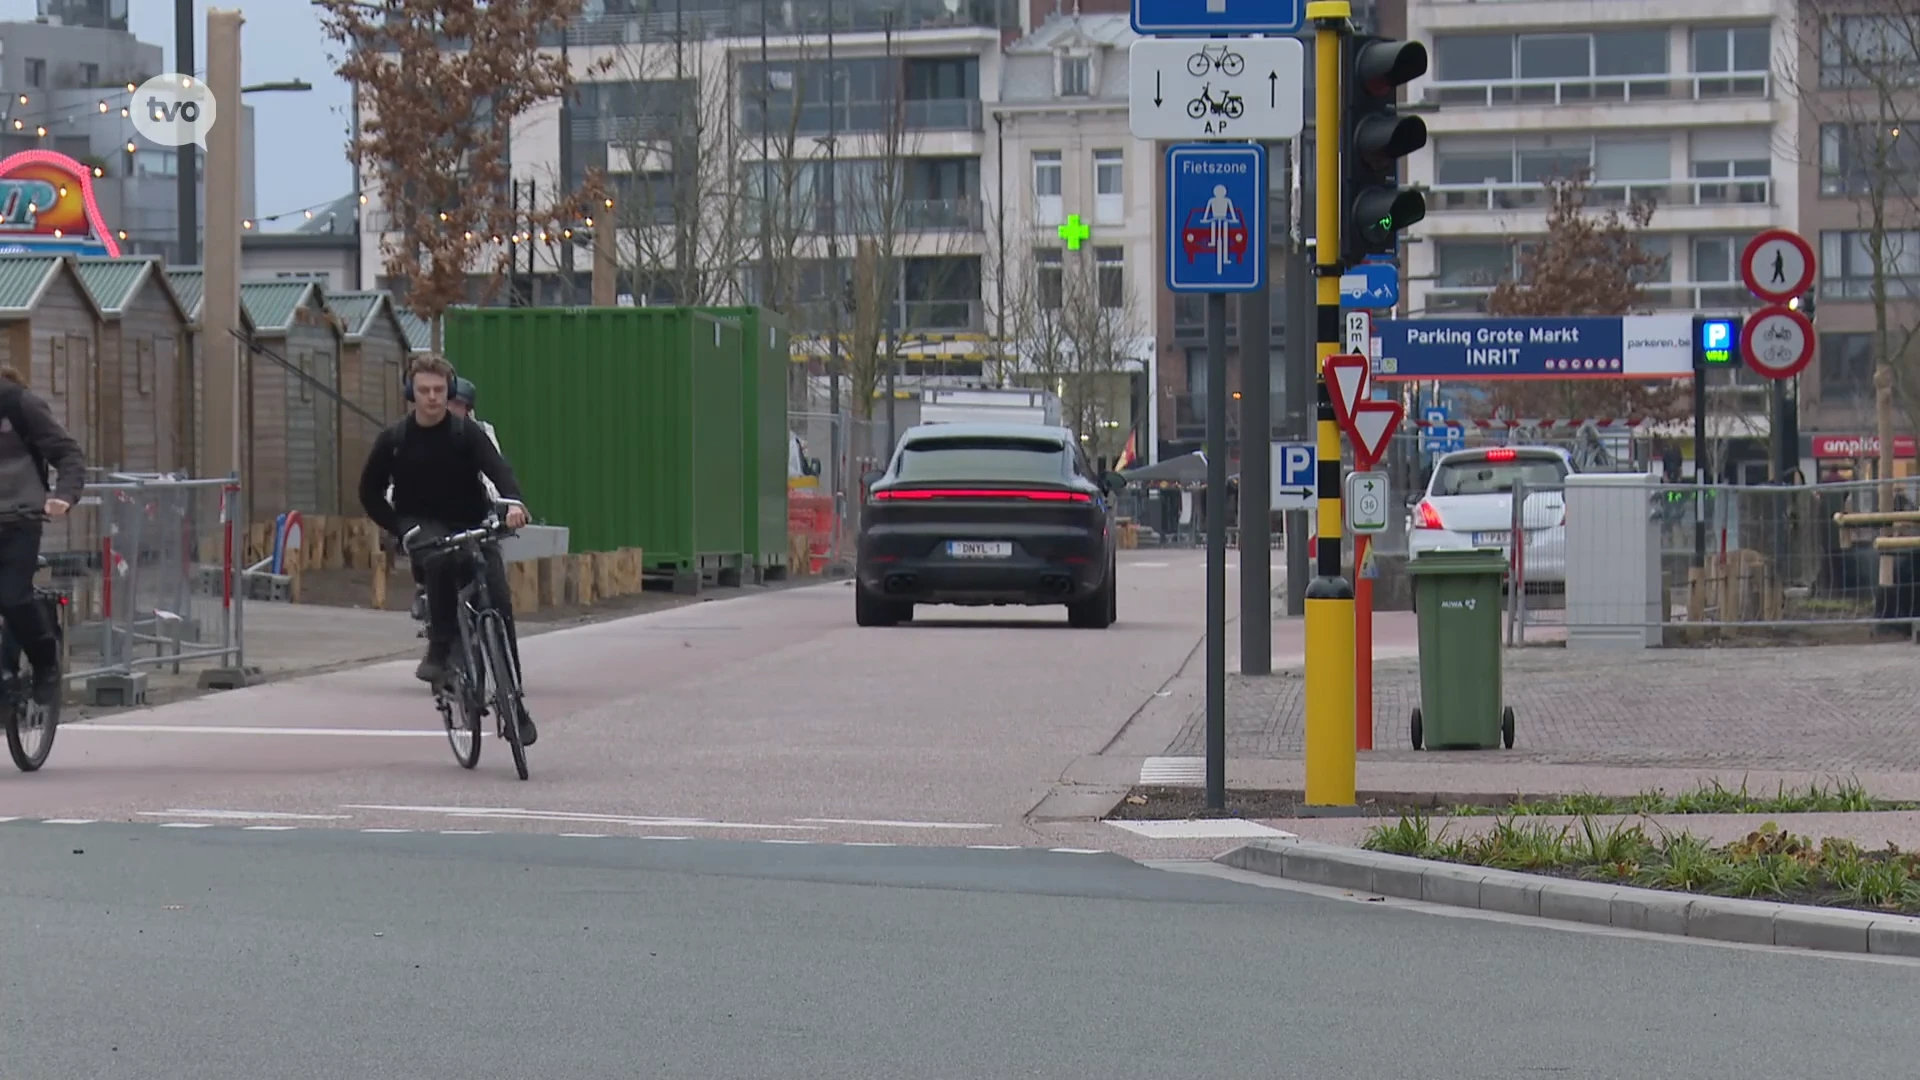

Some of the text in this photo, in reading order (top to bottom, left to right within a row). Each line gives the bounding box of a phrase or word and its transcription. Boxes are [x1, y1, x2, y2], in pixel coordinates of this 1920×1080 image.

[1183, 160, 1247, 174] Fietszone
[1350, 317, 1363, 330] 12
[1351, 332, 1362, 342] m
[1407, 326, 1579, 346] Parking Grote Markt
[1709, 323, 1726, 349] P
[1627, 337, 1691, 350] parkeren.be
[1466, 348, 1520, 365] INRIT
[1286, 448, 1312, 486] P
[1363, 500, 1375, 510] 36
